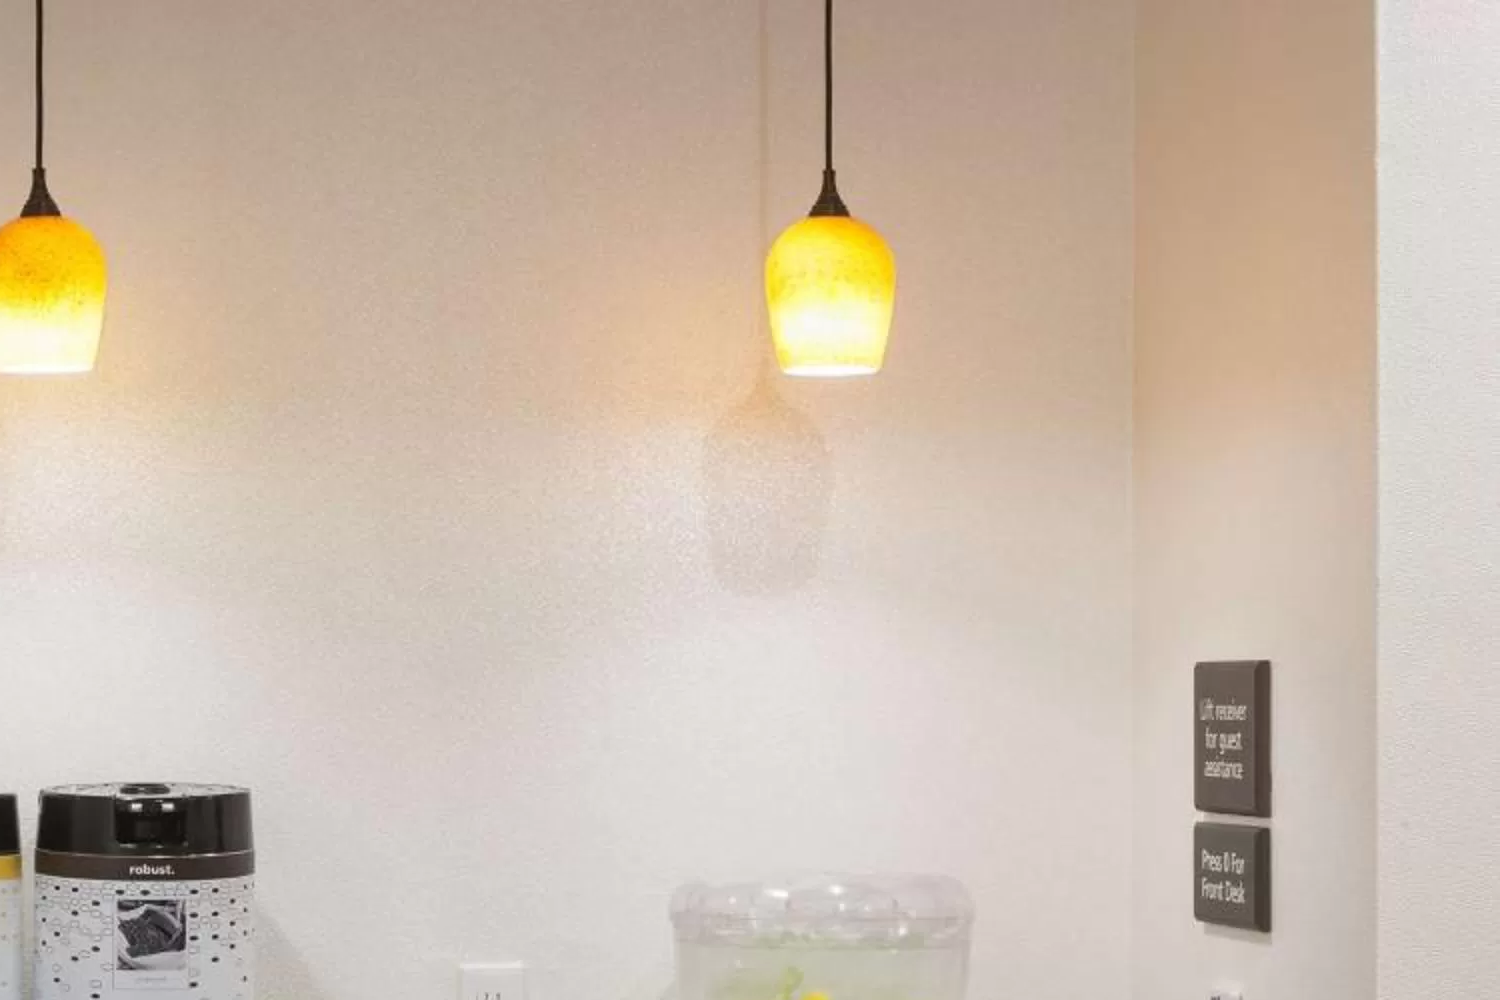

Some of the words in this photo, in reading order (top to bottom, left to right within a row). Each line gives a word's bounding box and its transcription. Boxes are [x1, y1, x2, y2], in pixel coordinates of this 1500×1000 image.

[1215, 697, 1247, 721] receiver
[1205, 727, 1218, 749] for
[1219, 732, 1242, 755] guest
[1204, 756, 1243, 780] assistance
[129, 863, 176, 876] robust.
[1201, 848, 1222, 872] Press
[1231, 852, 1244, 875] For
[1201, 876, 1223, 900] Front
[1225, 880, 1245, 904] Desk
